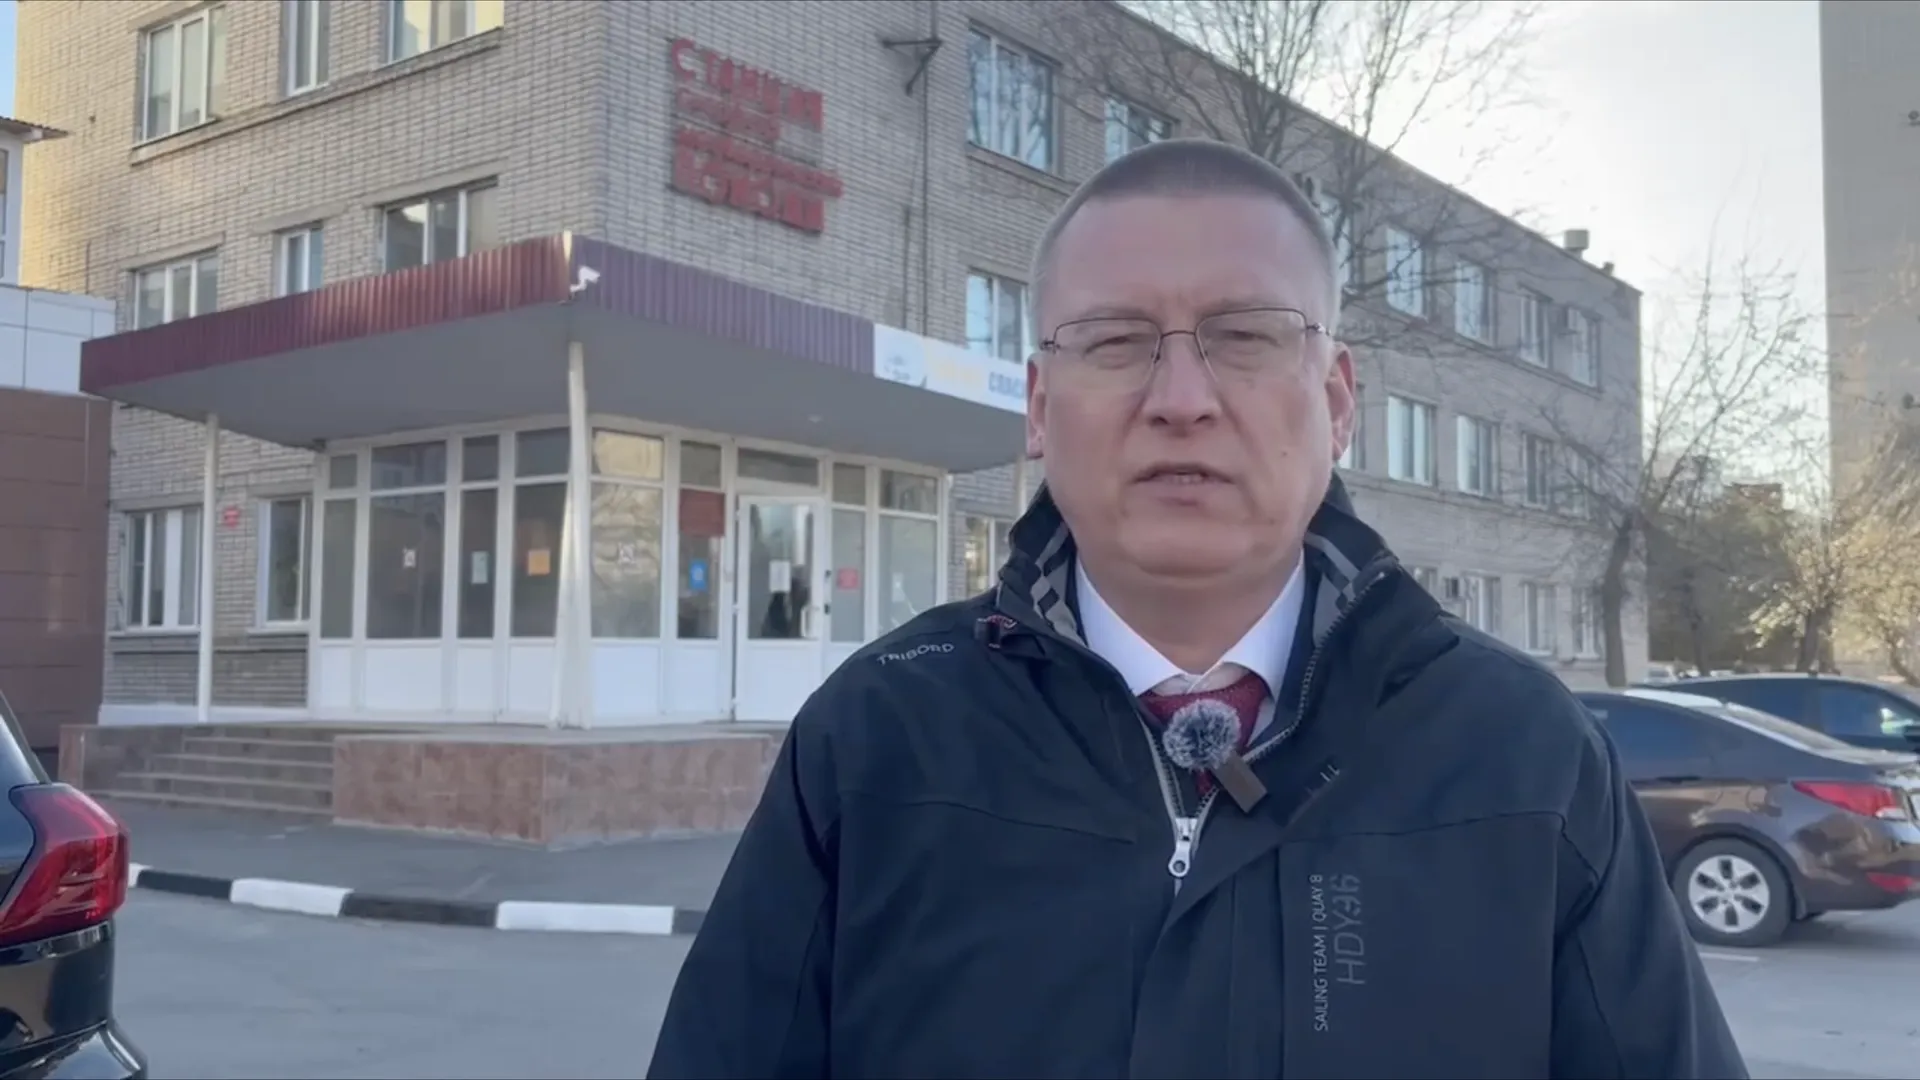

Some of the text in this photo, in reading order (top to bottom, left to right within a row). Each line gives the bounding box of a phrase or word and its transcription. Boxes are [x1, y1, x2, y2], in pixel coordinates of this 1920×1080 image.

[876, 642, 955, 666] TRIBORD
[1308, 874, 1323, 884] 8
[1310, 886, 1328, 922] QUAY
[1312, 934, 1328, 974] TEAM
[1313, 978, 1329, 1032] SAILING
